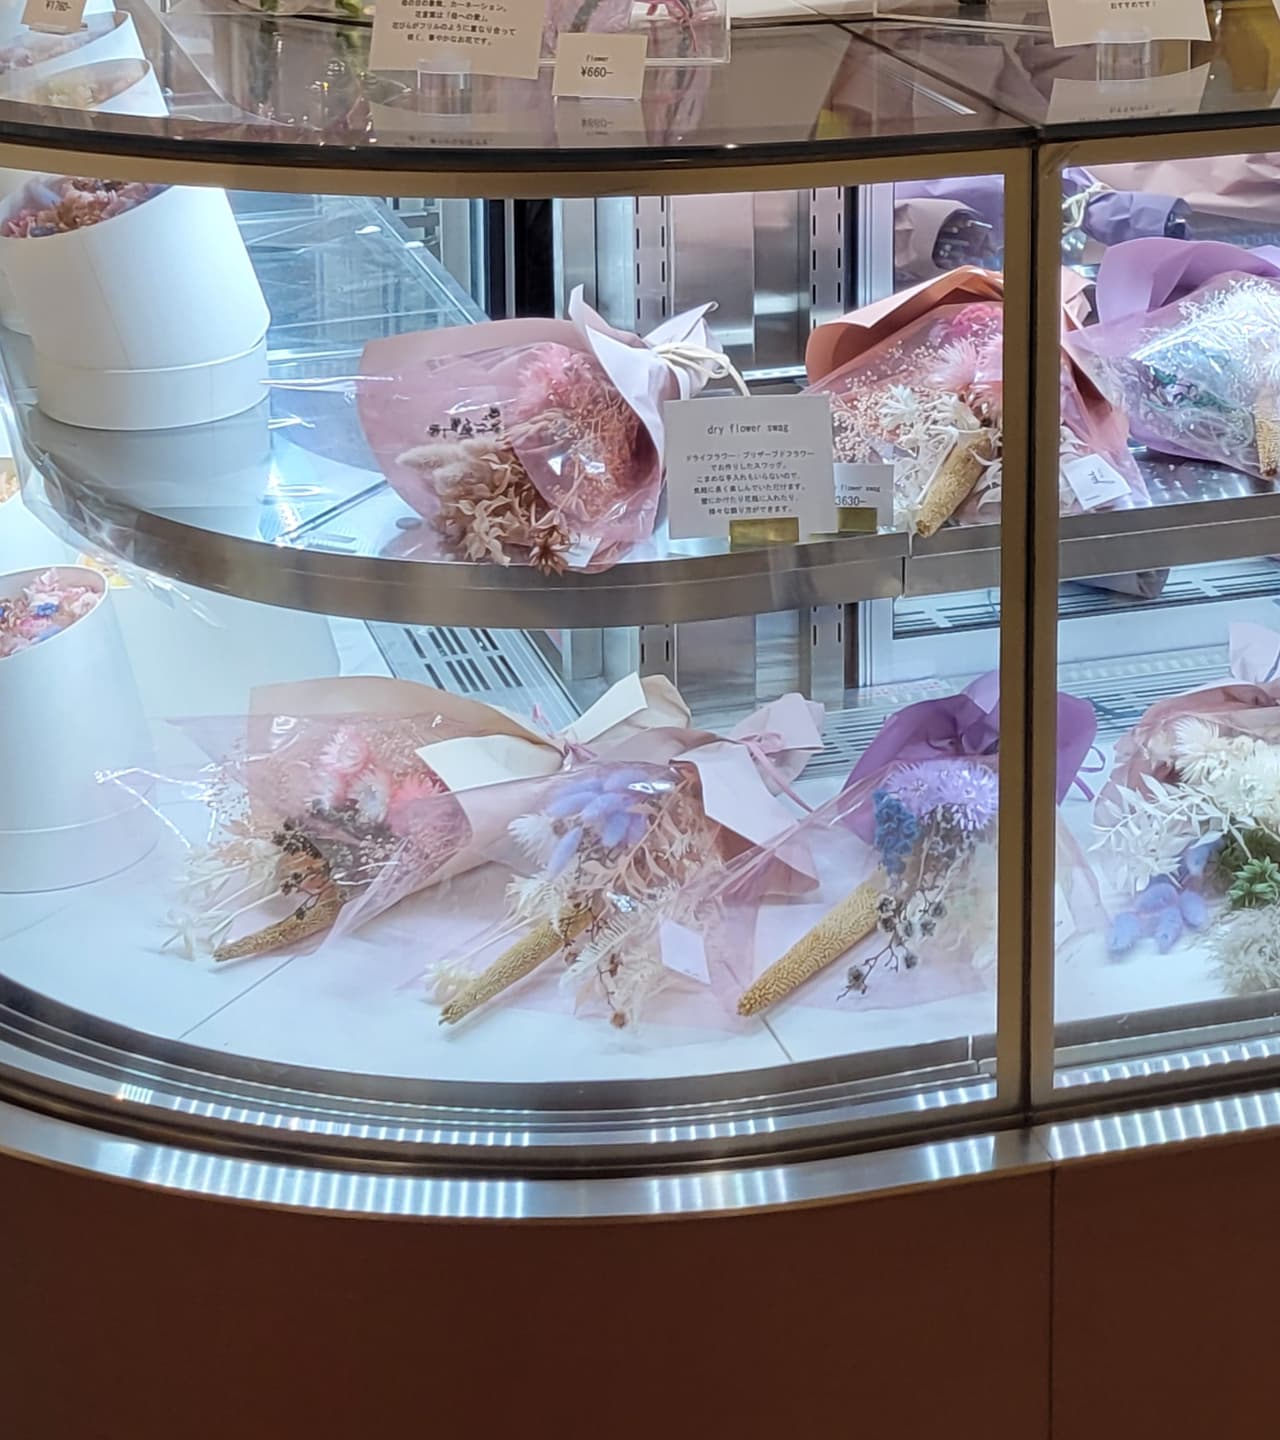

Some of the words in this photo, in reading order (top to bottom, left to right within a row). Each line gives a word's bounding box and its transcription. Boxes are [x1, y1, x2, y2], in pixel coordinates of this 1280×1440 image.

[706, 424, 725, 436] dry
[729, 423, 762, 434] flower
[767, 423, 790, 435] swag
